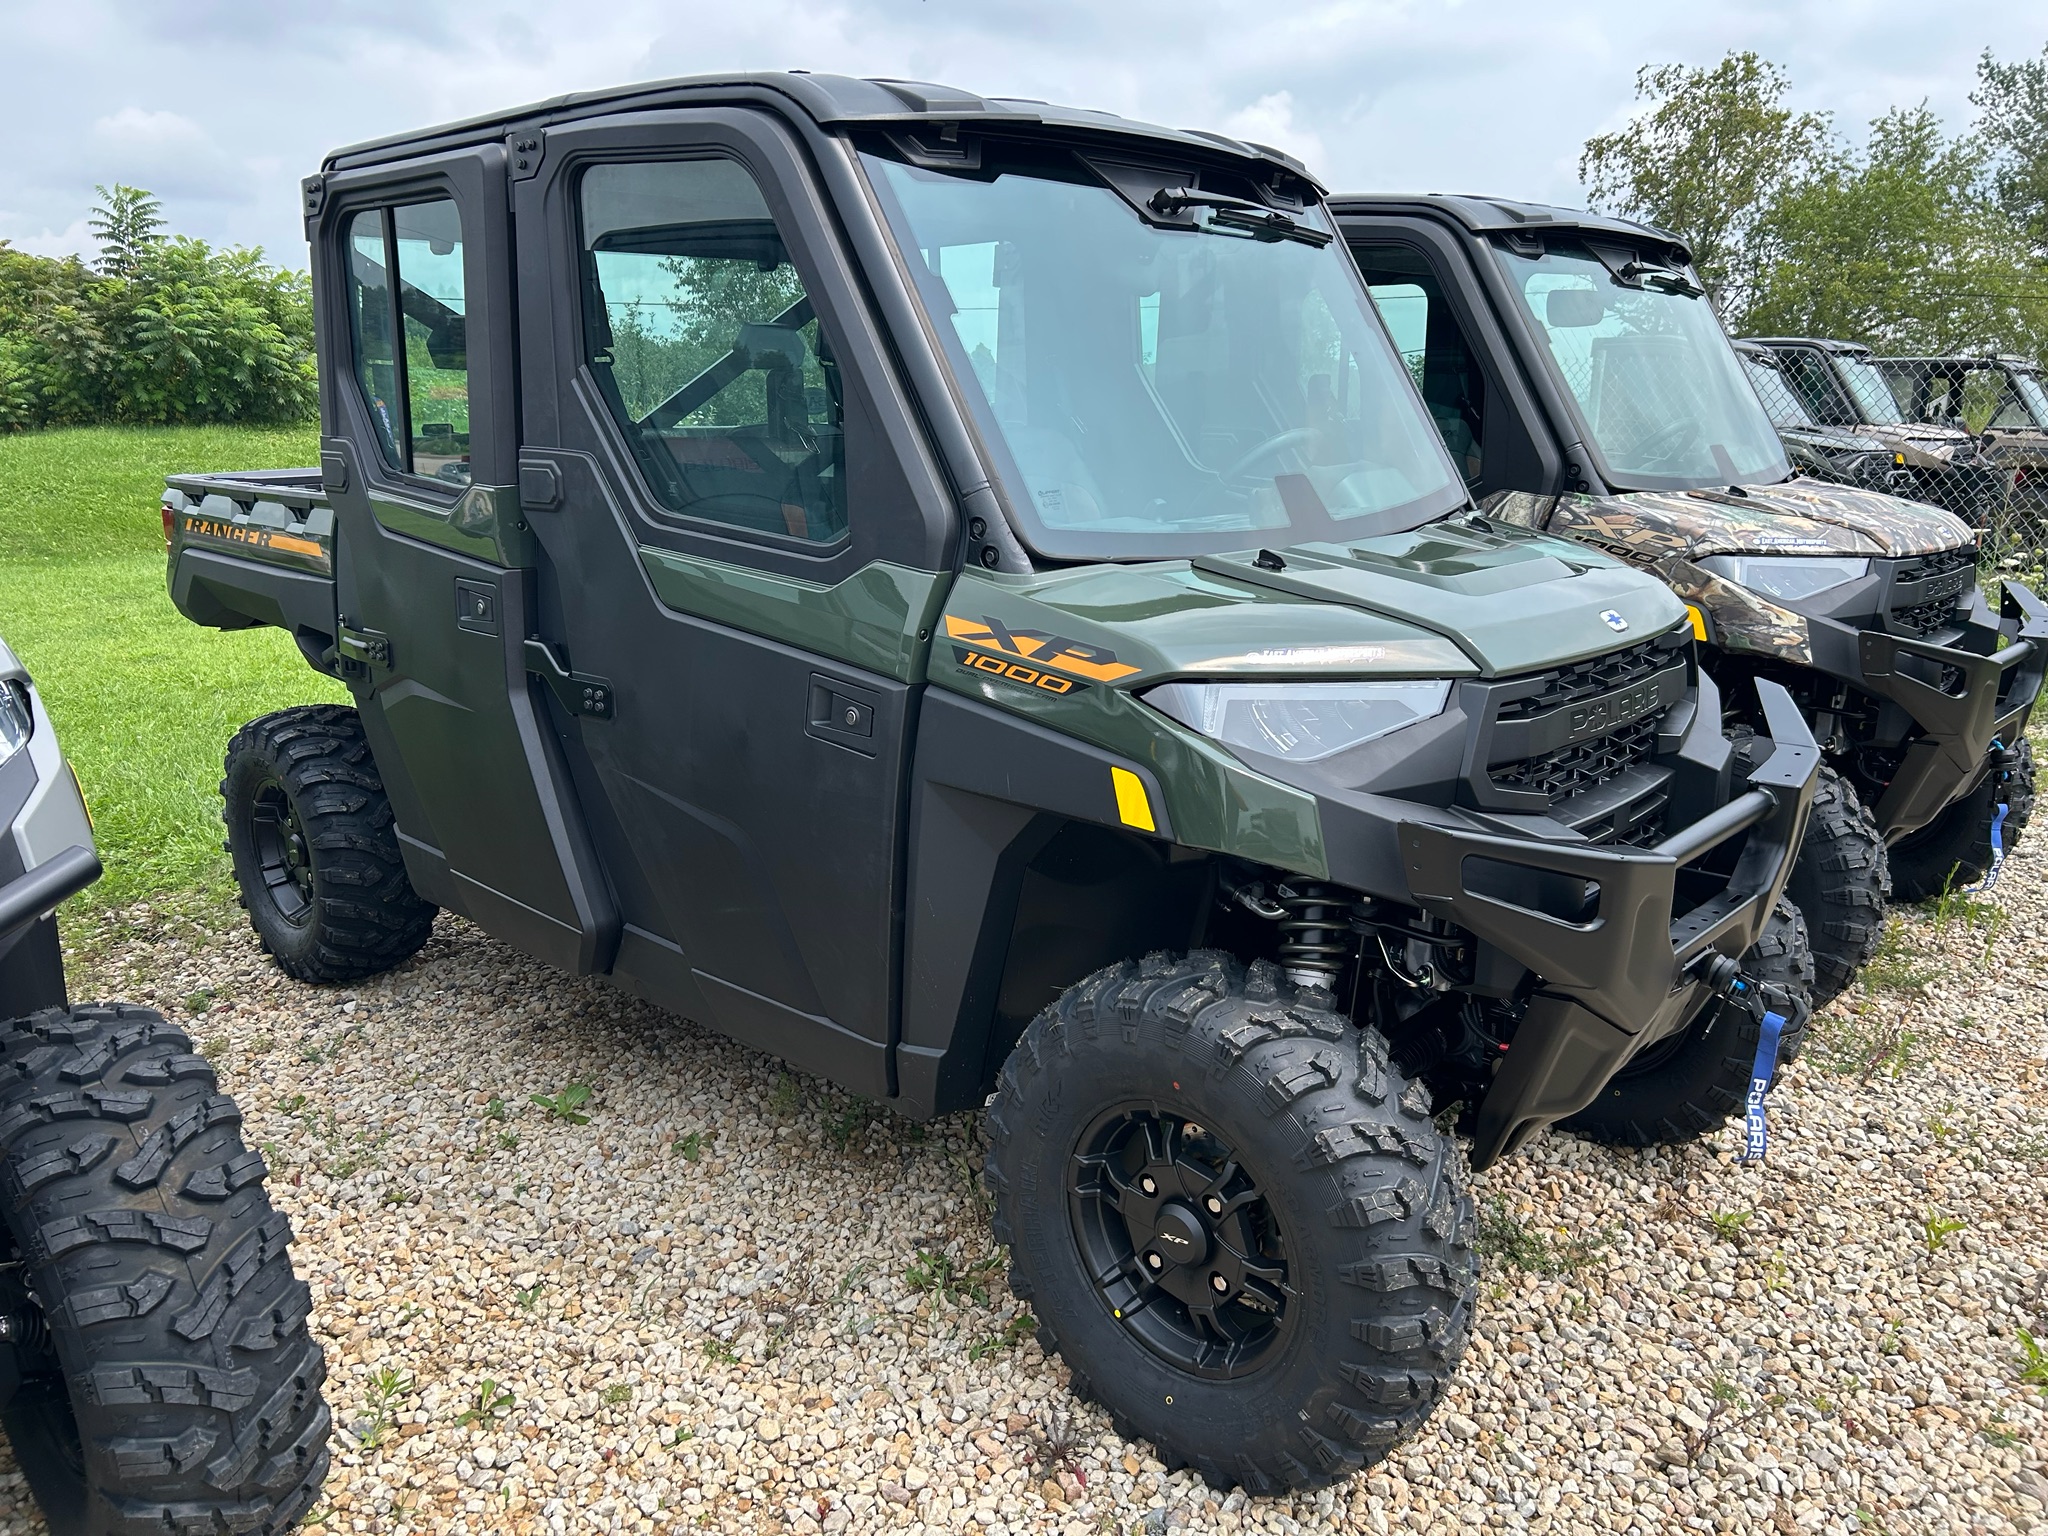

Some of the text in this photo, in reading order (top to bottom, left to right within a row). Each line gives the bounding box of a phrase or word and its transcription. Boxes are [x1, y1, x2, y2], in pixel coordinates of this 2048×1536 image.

[188, 518, 273, 546] RANGER
[1566, 514, 1688, 548] XP
[953, 614, 1118, 666] XP
[955, 667, 980, 679] DUAL
[1034, 692, 1058, 703] CAM
[963, 651, 1073, 695] 1000
[1569, 679, 1660, 738] POLARIS
[1983, 847, 2004, 889] POLAR
[1747, 1078, 1767, 1159] POLARIS
[1160, 1232, 1189, 1245] XP
